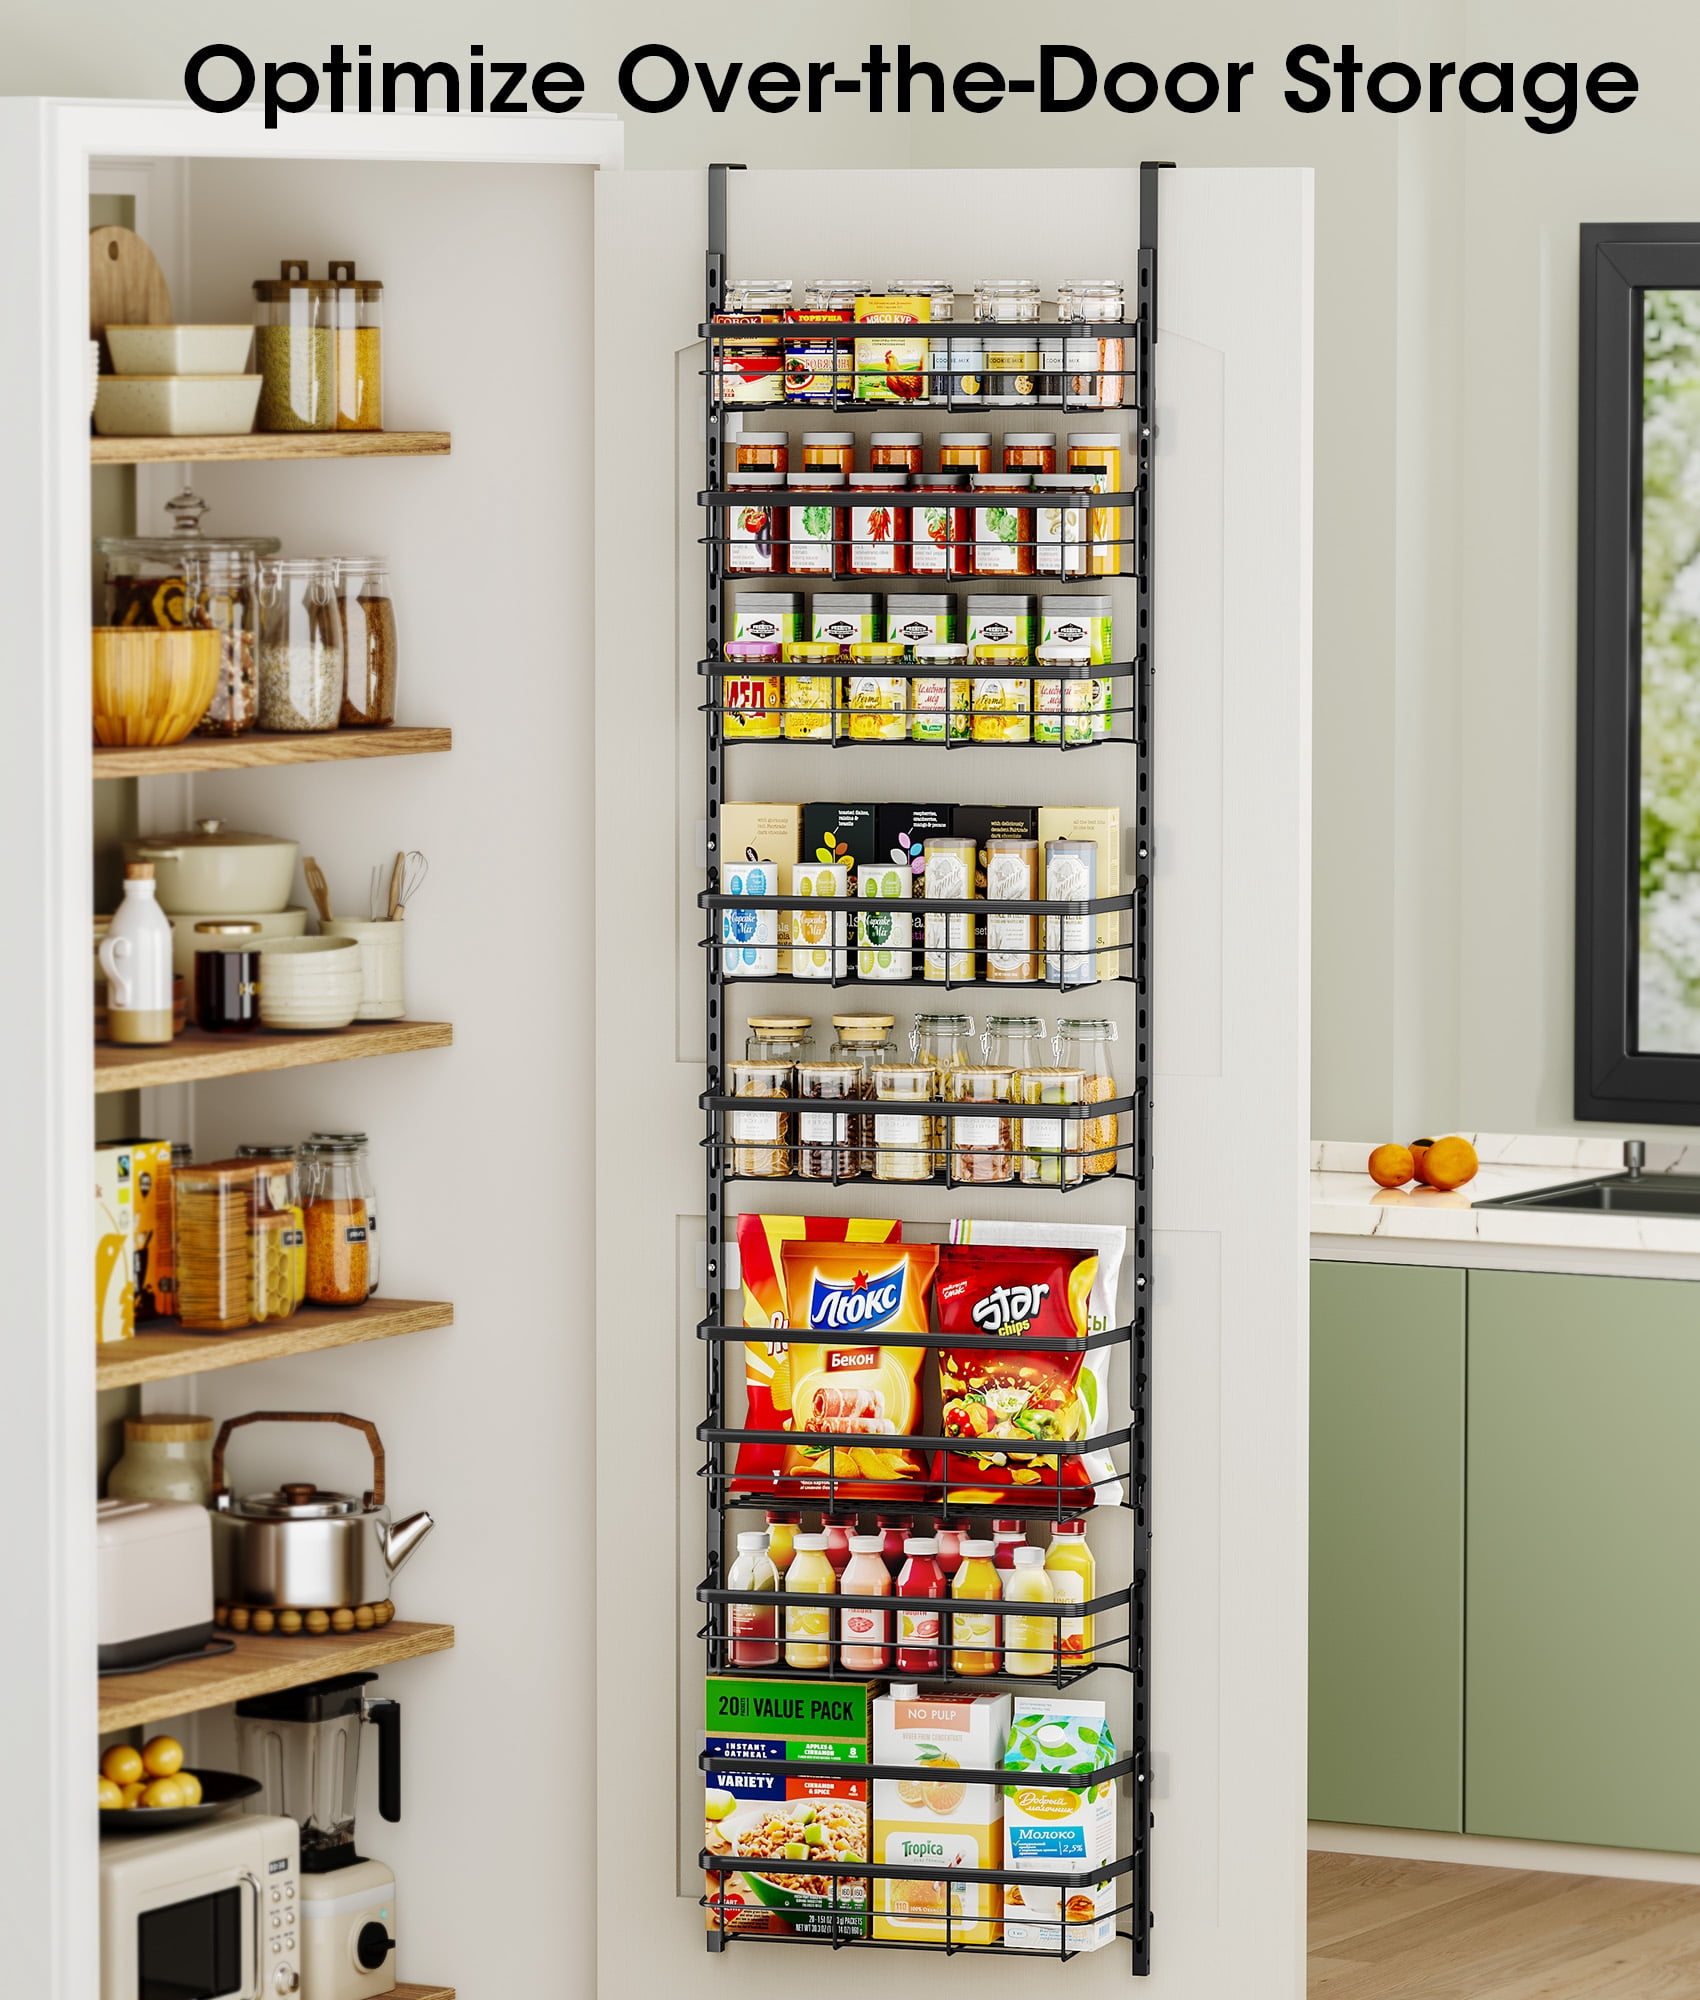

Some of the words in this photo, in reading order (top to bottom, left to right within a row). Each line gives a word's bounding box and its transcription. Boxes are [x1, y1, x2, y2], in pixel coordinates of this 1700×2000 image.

[731, 914, 755, 924] Cupcake
[801, 915, 825, 925] Cupcake
[866, 917, 890, 927] Cupcake
[739, 923, 752, 934] Mix
[810, 924, 823, 935] Mix
[875, 926, 888, 937] Mix
[998, 1319, 1031, 1336] chips
[831, 1353, 874, 1368] Бекон
[718, 1696, 739, 1716] 20
[753, 1697, 805, 1719] VALUE
[811, 1700, 854, 1721] PACK
[908, 1709, 927, 1720] NO
[931, 1710, 957, 1720] PULP
[725, 1742, 767, 1751] INSTANT
[849, 1747, 857, 1755] 8
[724, 1750, 768, 1759] OATMEAL
[804, 1749, 835, 1757] CINNAMON
[717, 1775, 775, 1789] VARIETY
[804, 1782, 835, 1790] CINNAMON
[849, 1785, 857, 1793] 4
[1019, 1792, 1067, 1807] Добрый
[1019, 1829, 1076, 1840] Молоко
[901, 1840, 943, 1857] Tropica
[1062, 1844, 1083, 1854] 2,5%
[841, 1888, 850, 1896] 160
[844, 1916, 863, 1926] PACKETS
[795, 1923, 804, 1932] NET
[804, 1924, 811, 1932] WT
